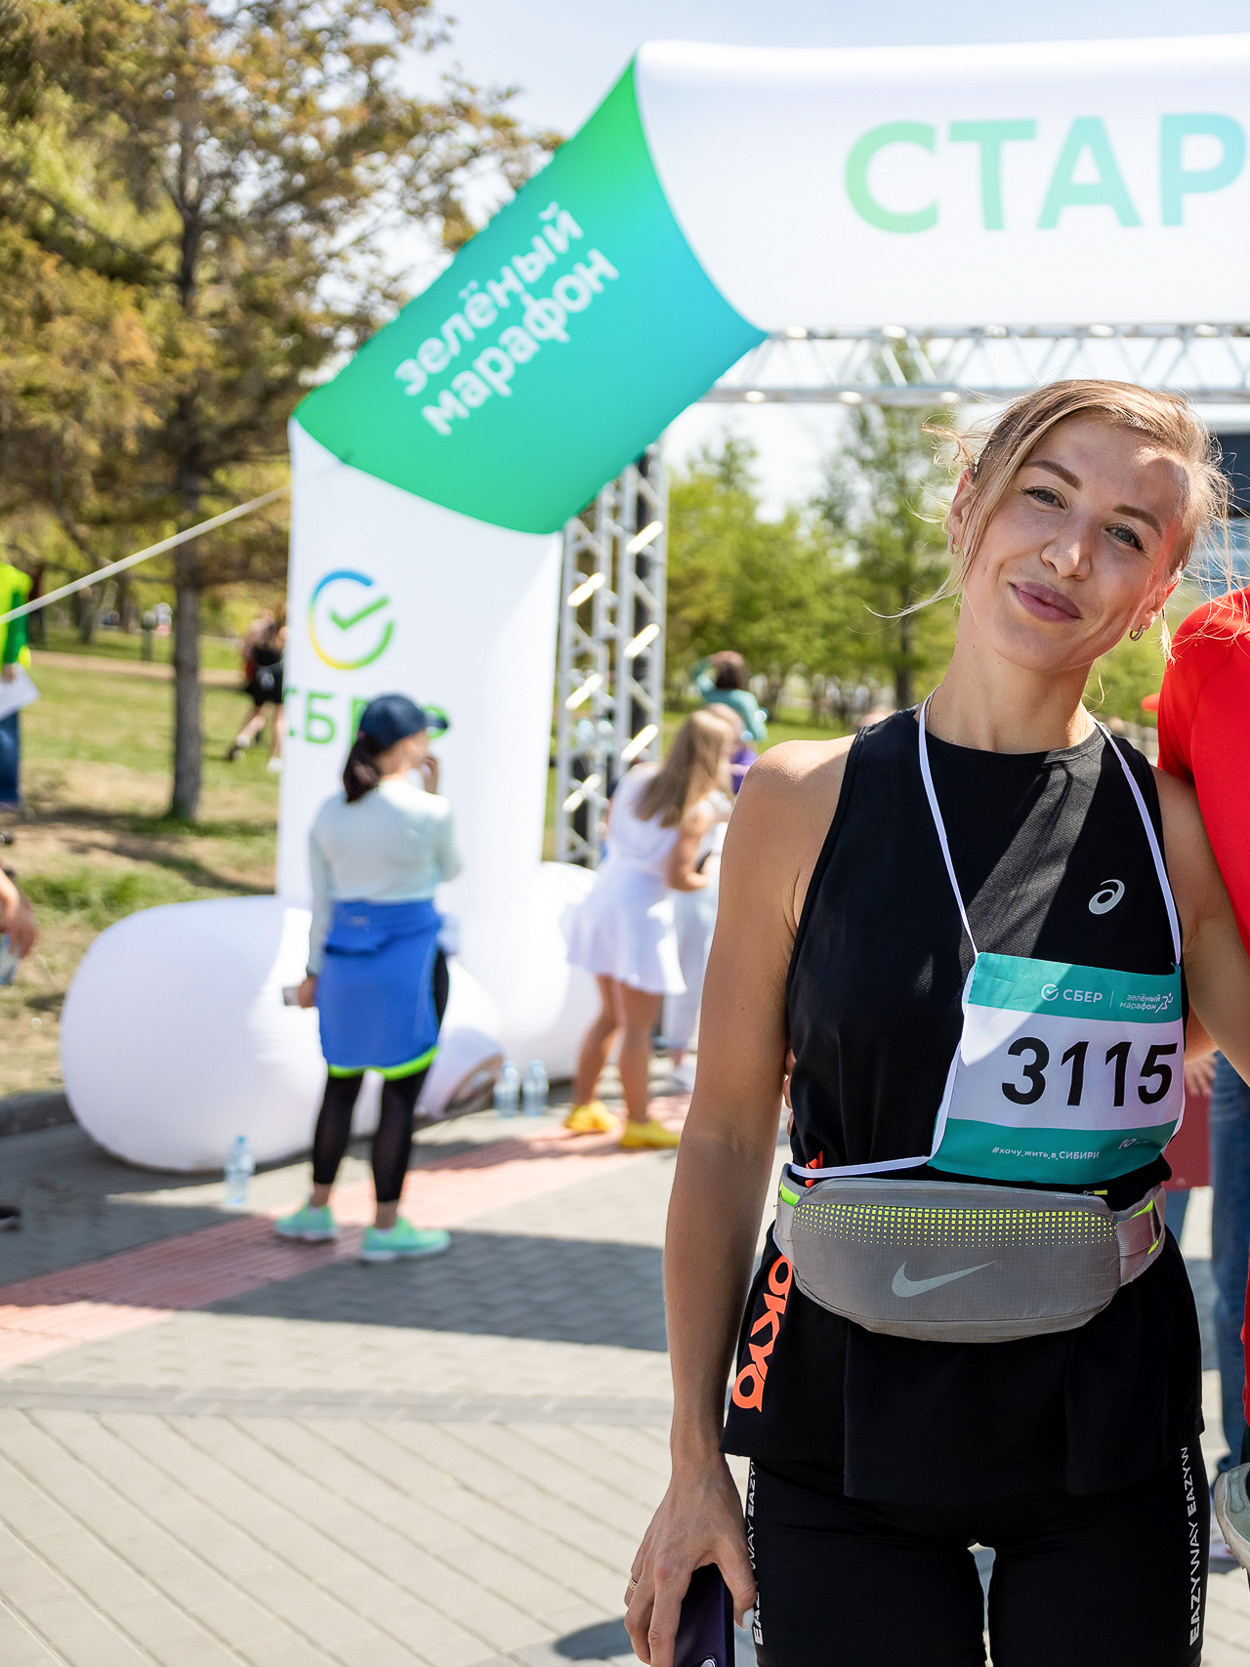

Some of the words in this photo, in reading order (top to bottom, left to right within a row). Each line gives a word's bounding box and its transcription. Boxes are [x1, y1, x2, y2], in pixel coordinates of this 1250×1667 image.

[394, 201, 584, 397] зелёный
[421, 248, 620, 436] марафон
[1062, 988, 1103, 1003] СБЕР
[1120, 1001, 1157, 1011] марафон
[1001, 1036, 1178, 1107] 3115
